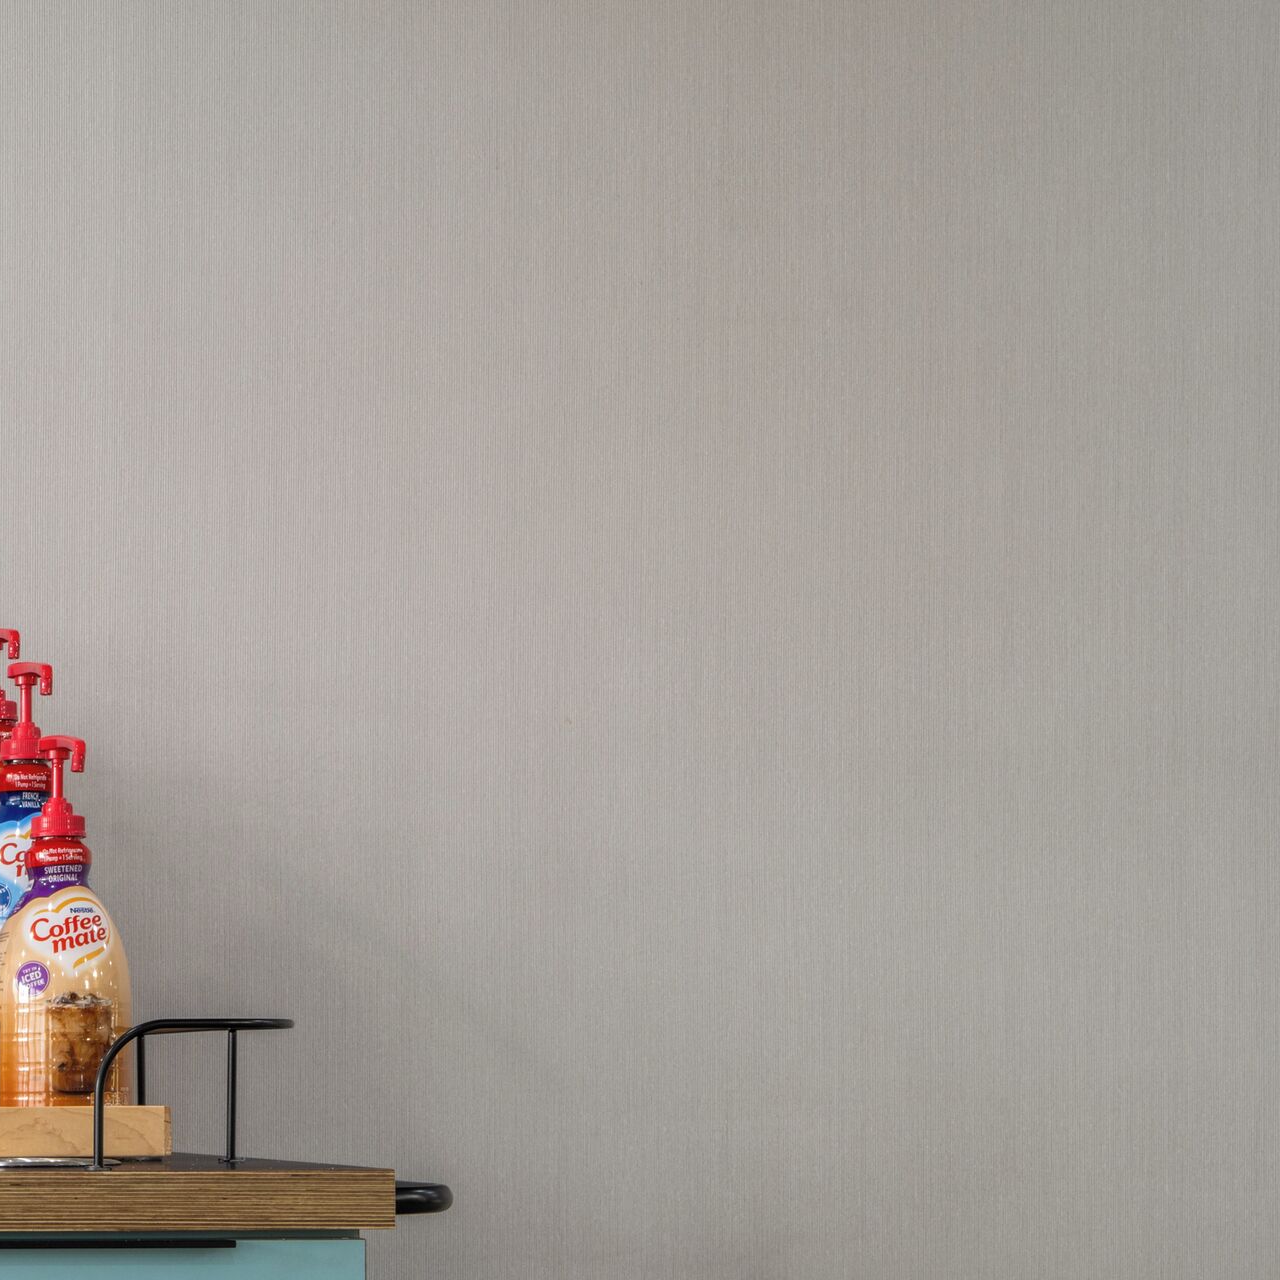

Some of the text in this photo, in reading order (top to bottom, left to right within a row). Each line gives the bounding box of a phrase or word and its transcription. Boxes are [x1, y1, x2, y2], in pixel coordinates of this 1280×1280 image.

[44, 864, 82, 874] SWEETENED
[48, 874, 78, 883] ORIGINAL
[30, 915, 102, 942] Coffee
[52, 927, 107, 954] mate
[21, 970, 42, 986] ICED
